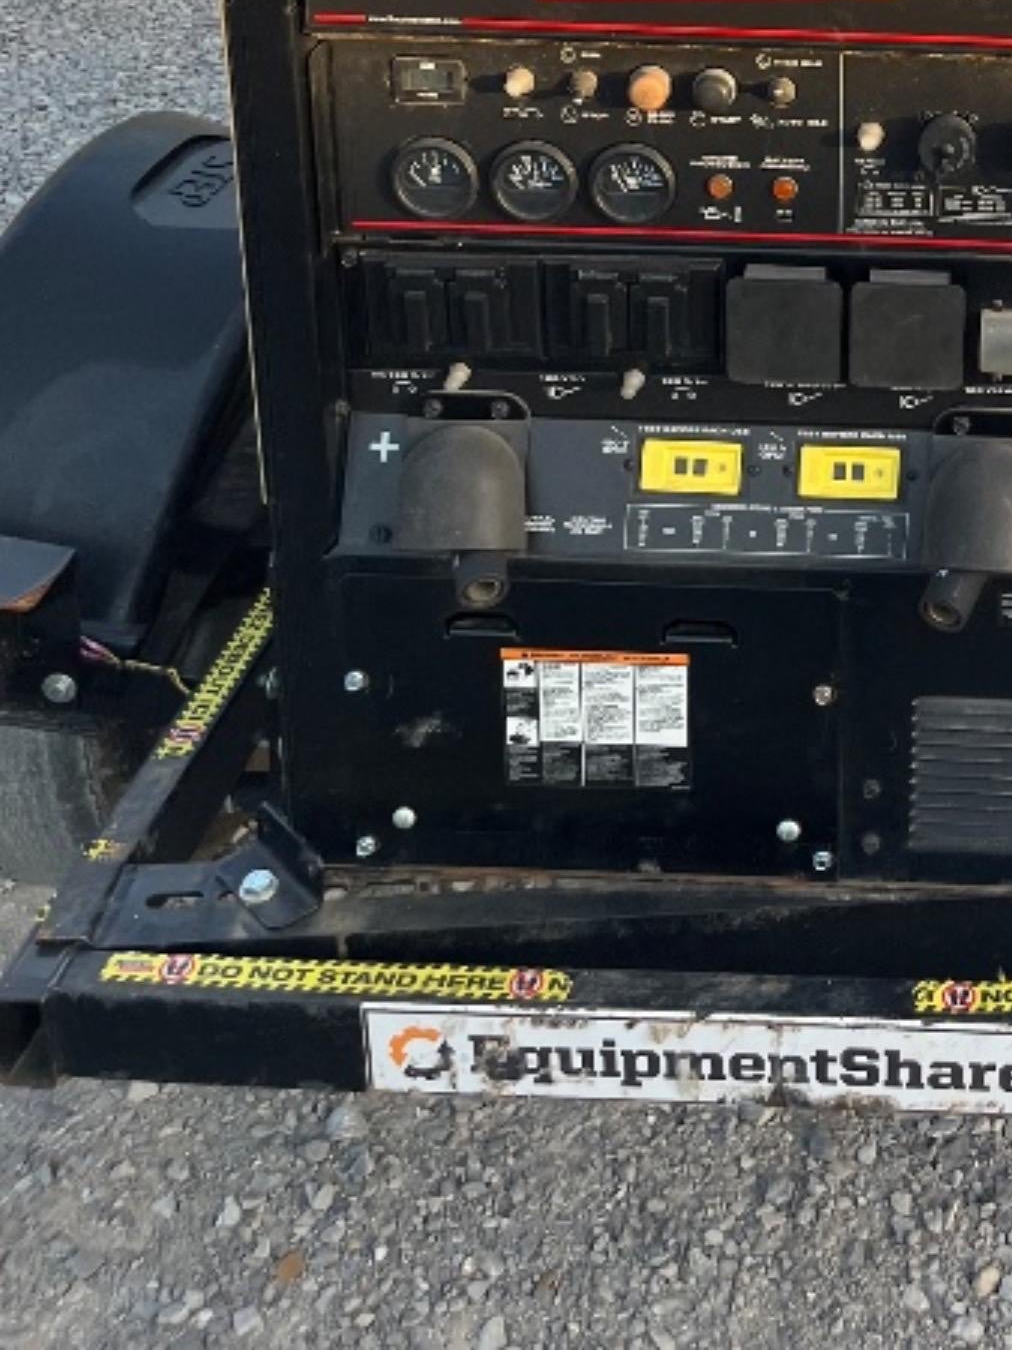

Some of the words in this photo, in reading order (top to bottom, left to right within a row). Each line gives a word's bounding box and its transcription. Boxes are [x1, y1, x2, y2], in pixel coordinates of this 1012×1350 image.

[196, 961, 243, 980] DO
[248, 965, 315, 983] NOT
[316, 968, 418, 987] STAND
